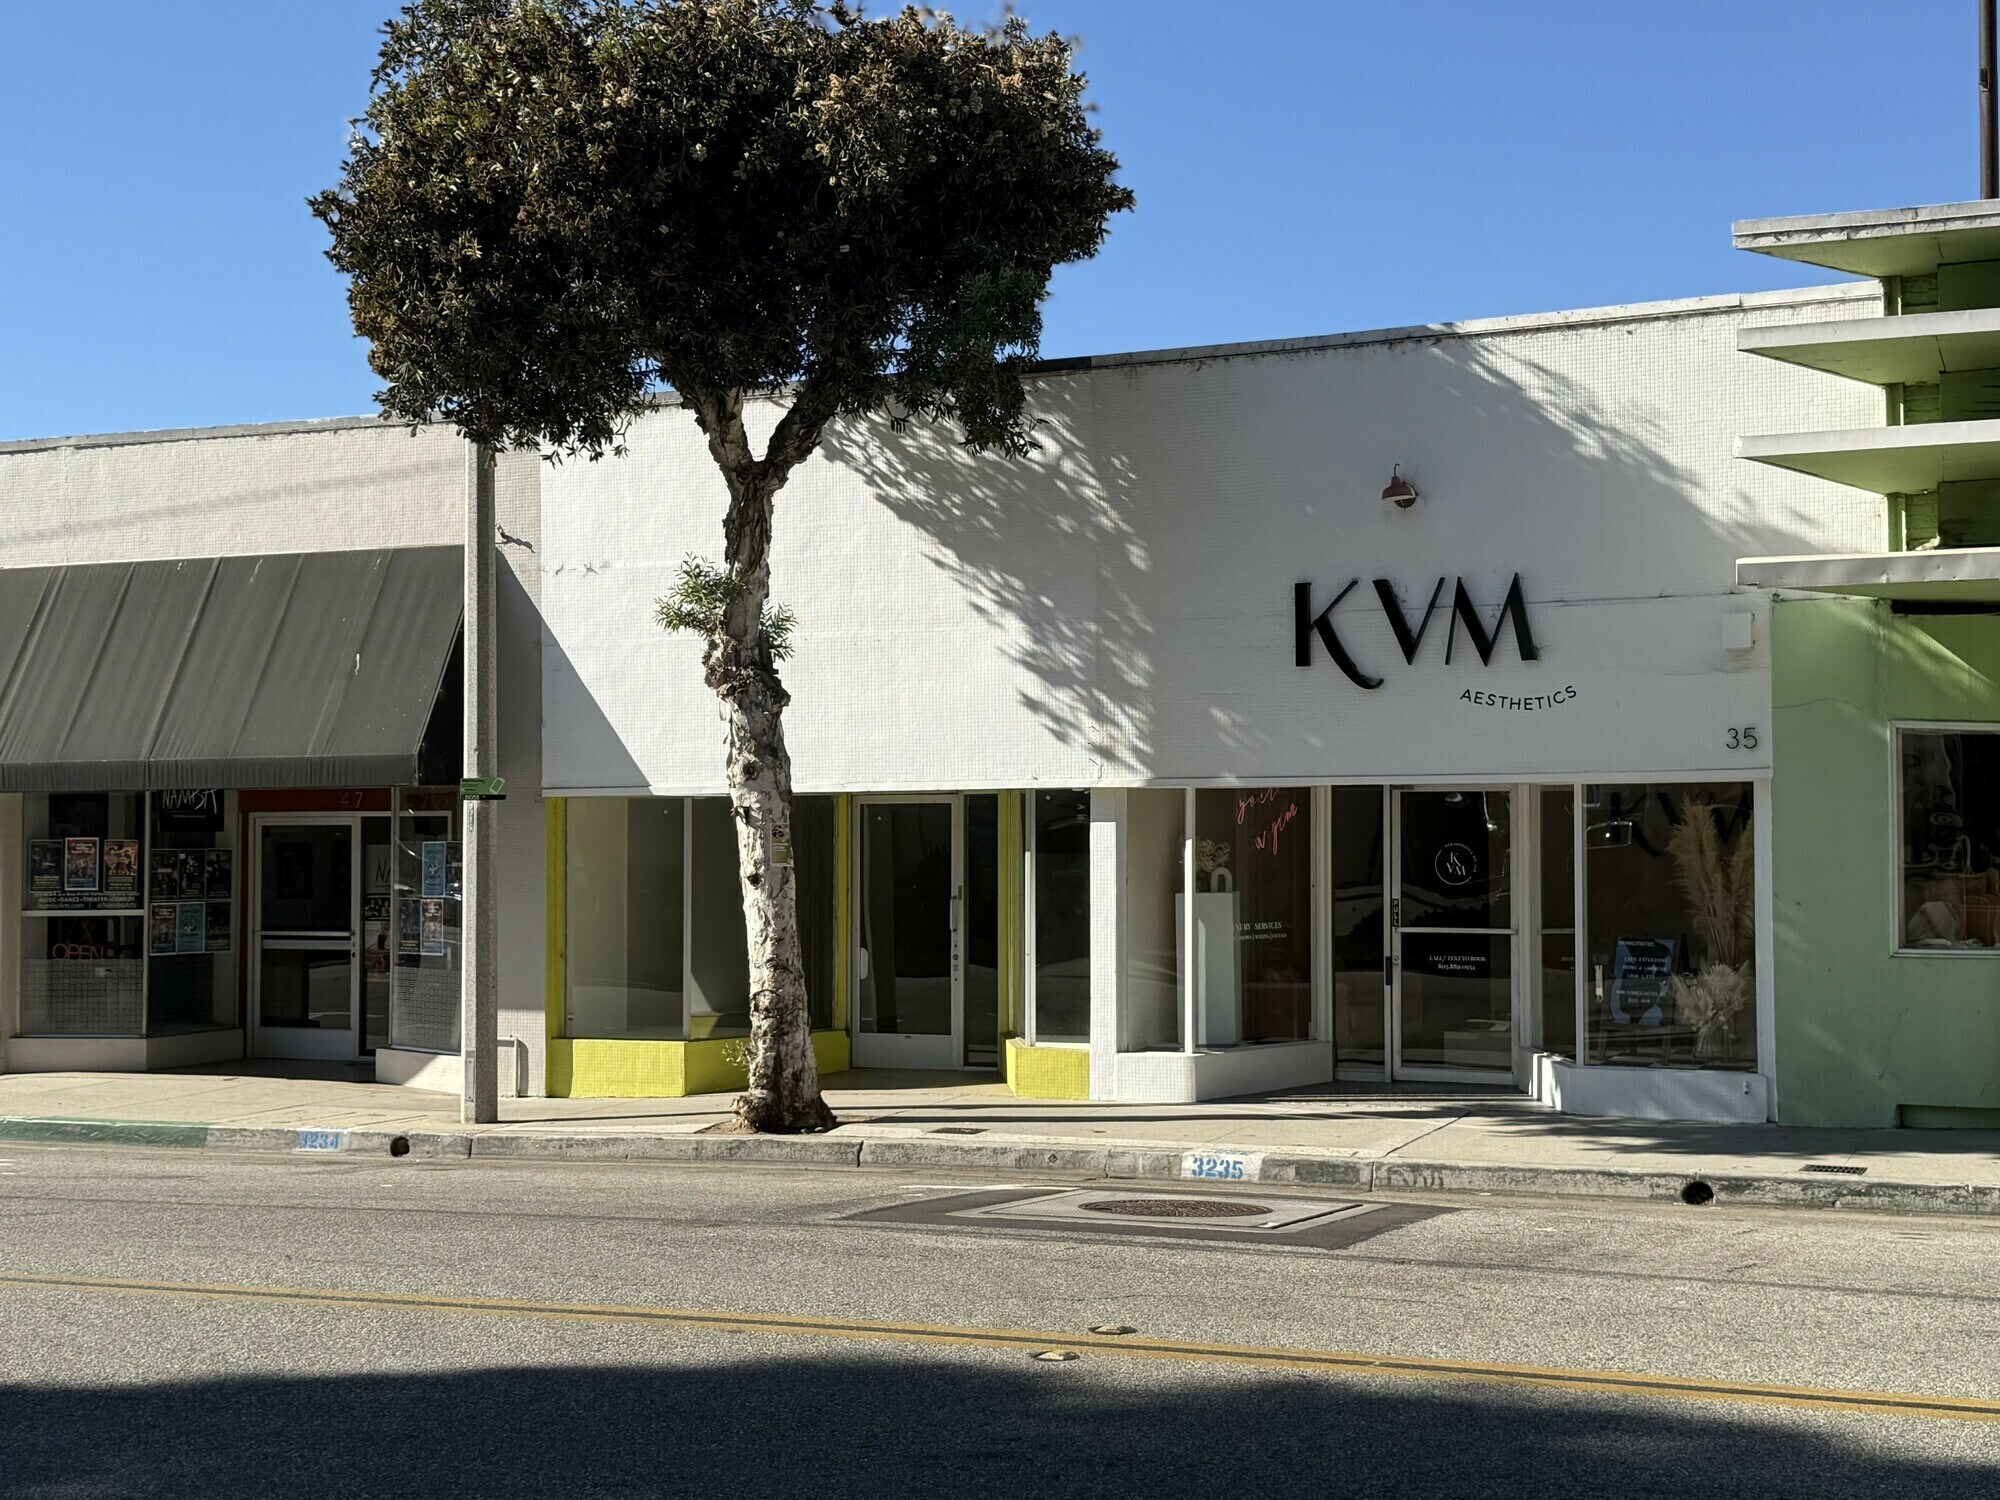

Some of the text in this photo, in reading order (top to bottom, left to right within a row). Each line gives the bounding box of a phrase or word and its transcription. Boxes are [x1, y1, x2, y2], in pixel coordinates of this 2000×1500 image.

[1295, 572, 1538, 689] KVM
[1460, 685, 1577, 710] AESTHETICS
[1726, 727, 1757, 749] 35
[340, 791, 363, 808] 47
[52, 943, 104, 960] OPEN
[1191, 1157, 1243, 1179] 3235
